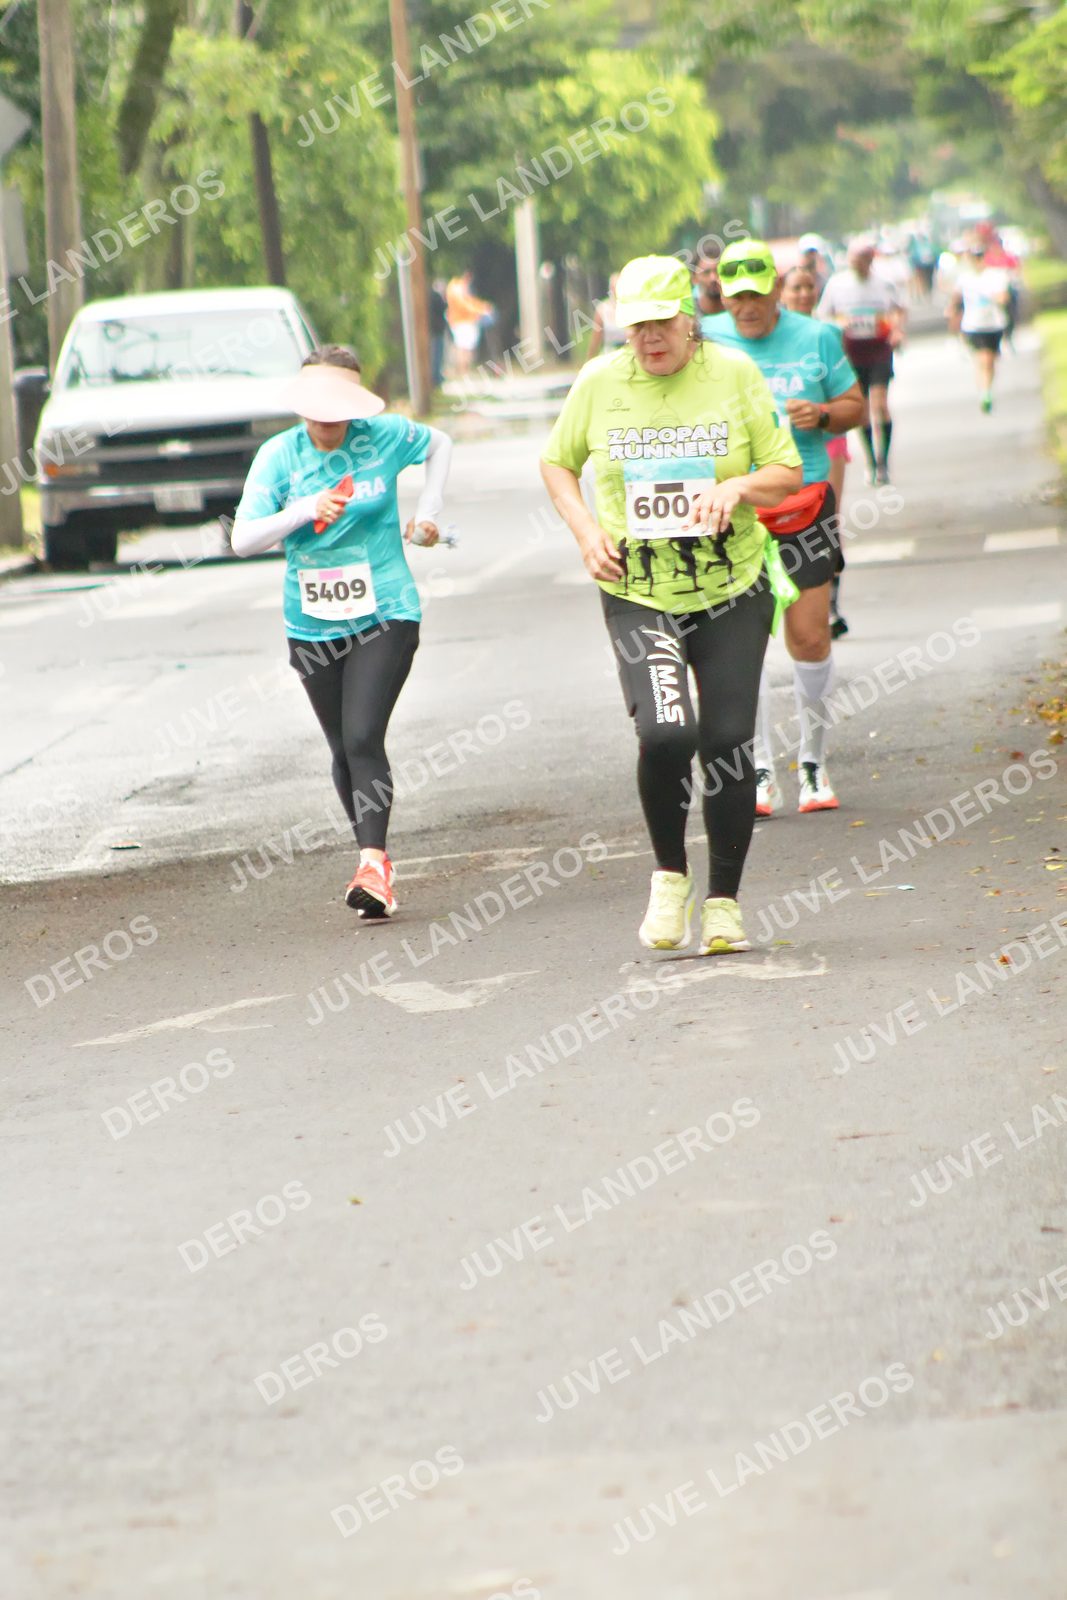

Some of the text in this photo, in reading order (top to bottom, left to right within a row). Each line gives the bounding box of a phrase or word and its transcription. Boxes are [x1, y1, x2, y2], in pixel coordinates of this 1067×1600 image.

[608, 421, 728, 445] ZAPOPAN
[609, 438, 728, 461] RUNNERS
[634, 494, 702, 519] 600
[305, 579, 366, 602] 5409
[657, 665, 685, 723] MAS
